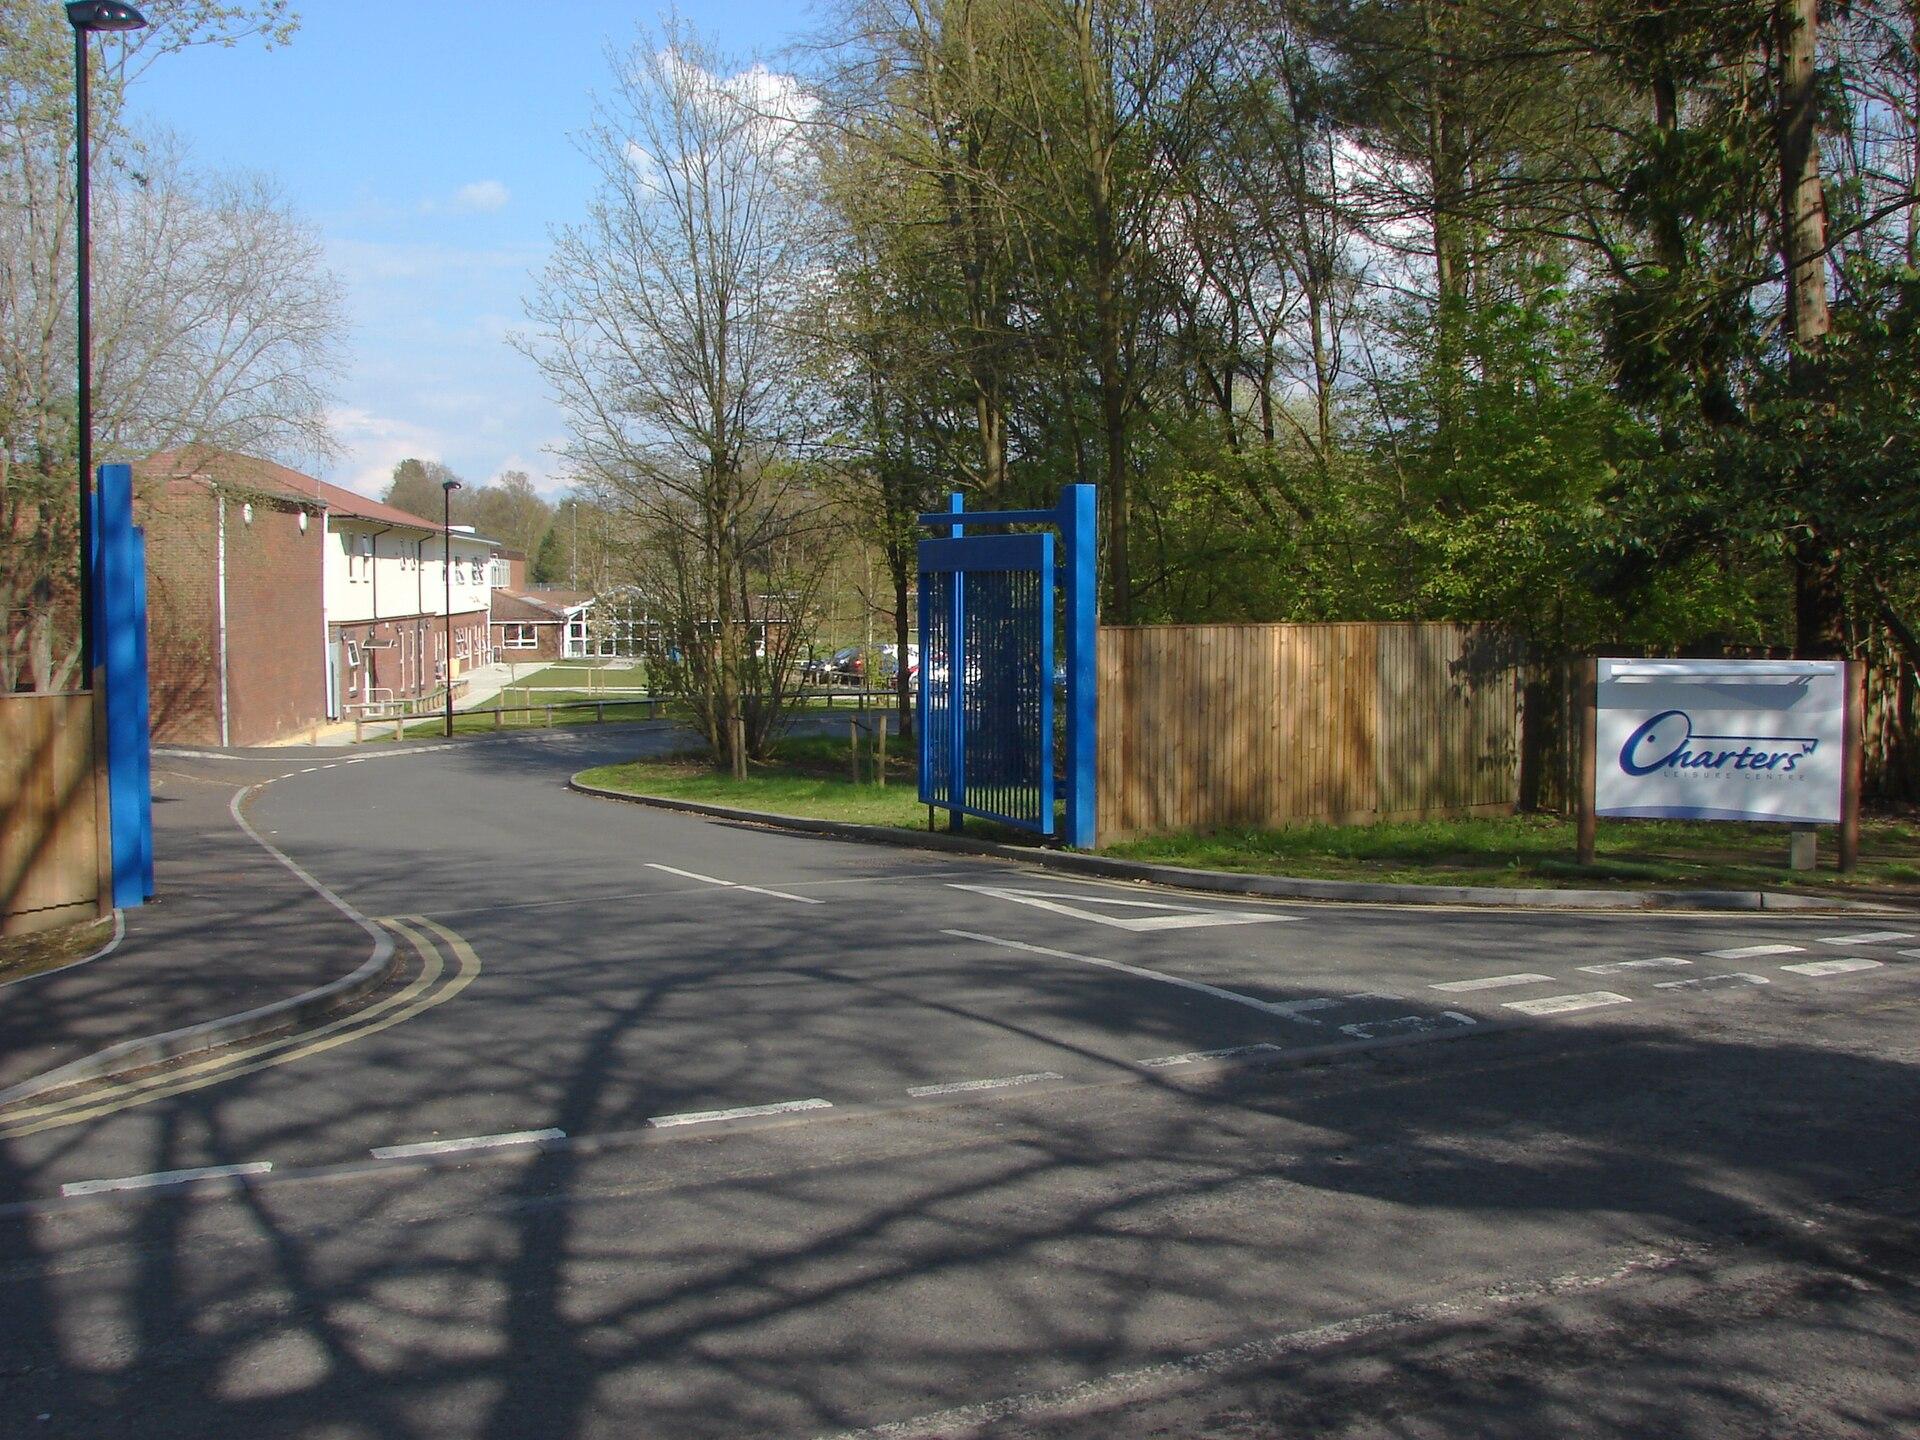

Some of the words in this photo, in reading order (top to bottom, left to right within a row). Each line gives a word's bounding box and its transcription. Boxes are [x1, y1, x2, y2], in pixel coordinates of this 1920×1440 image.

[1619, 710, 1810, 777] Charters
[1663, 771, 1732, 780] LEISURE
[1744, 772, 1806, 782] CENTRE
